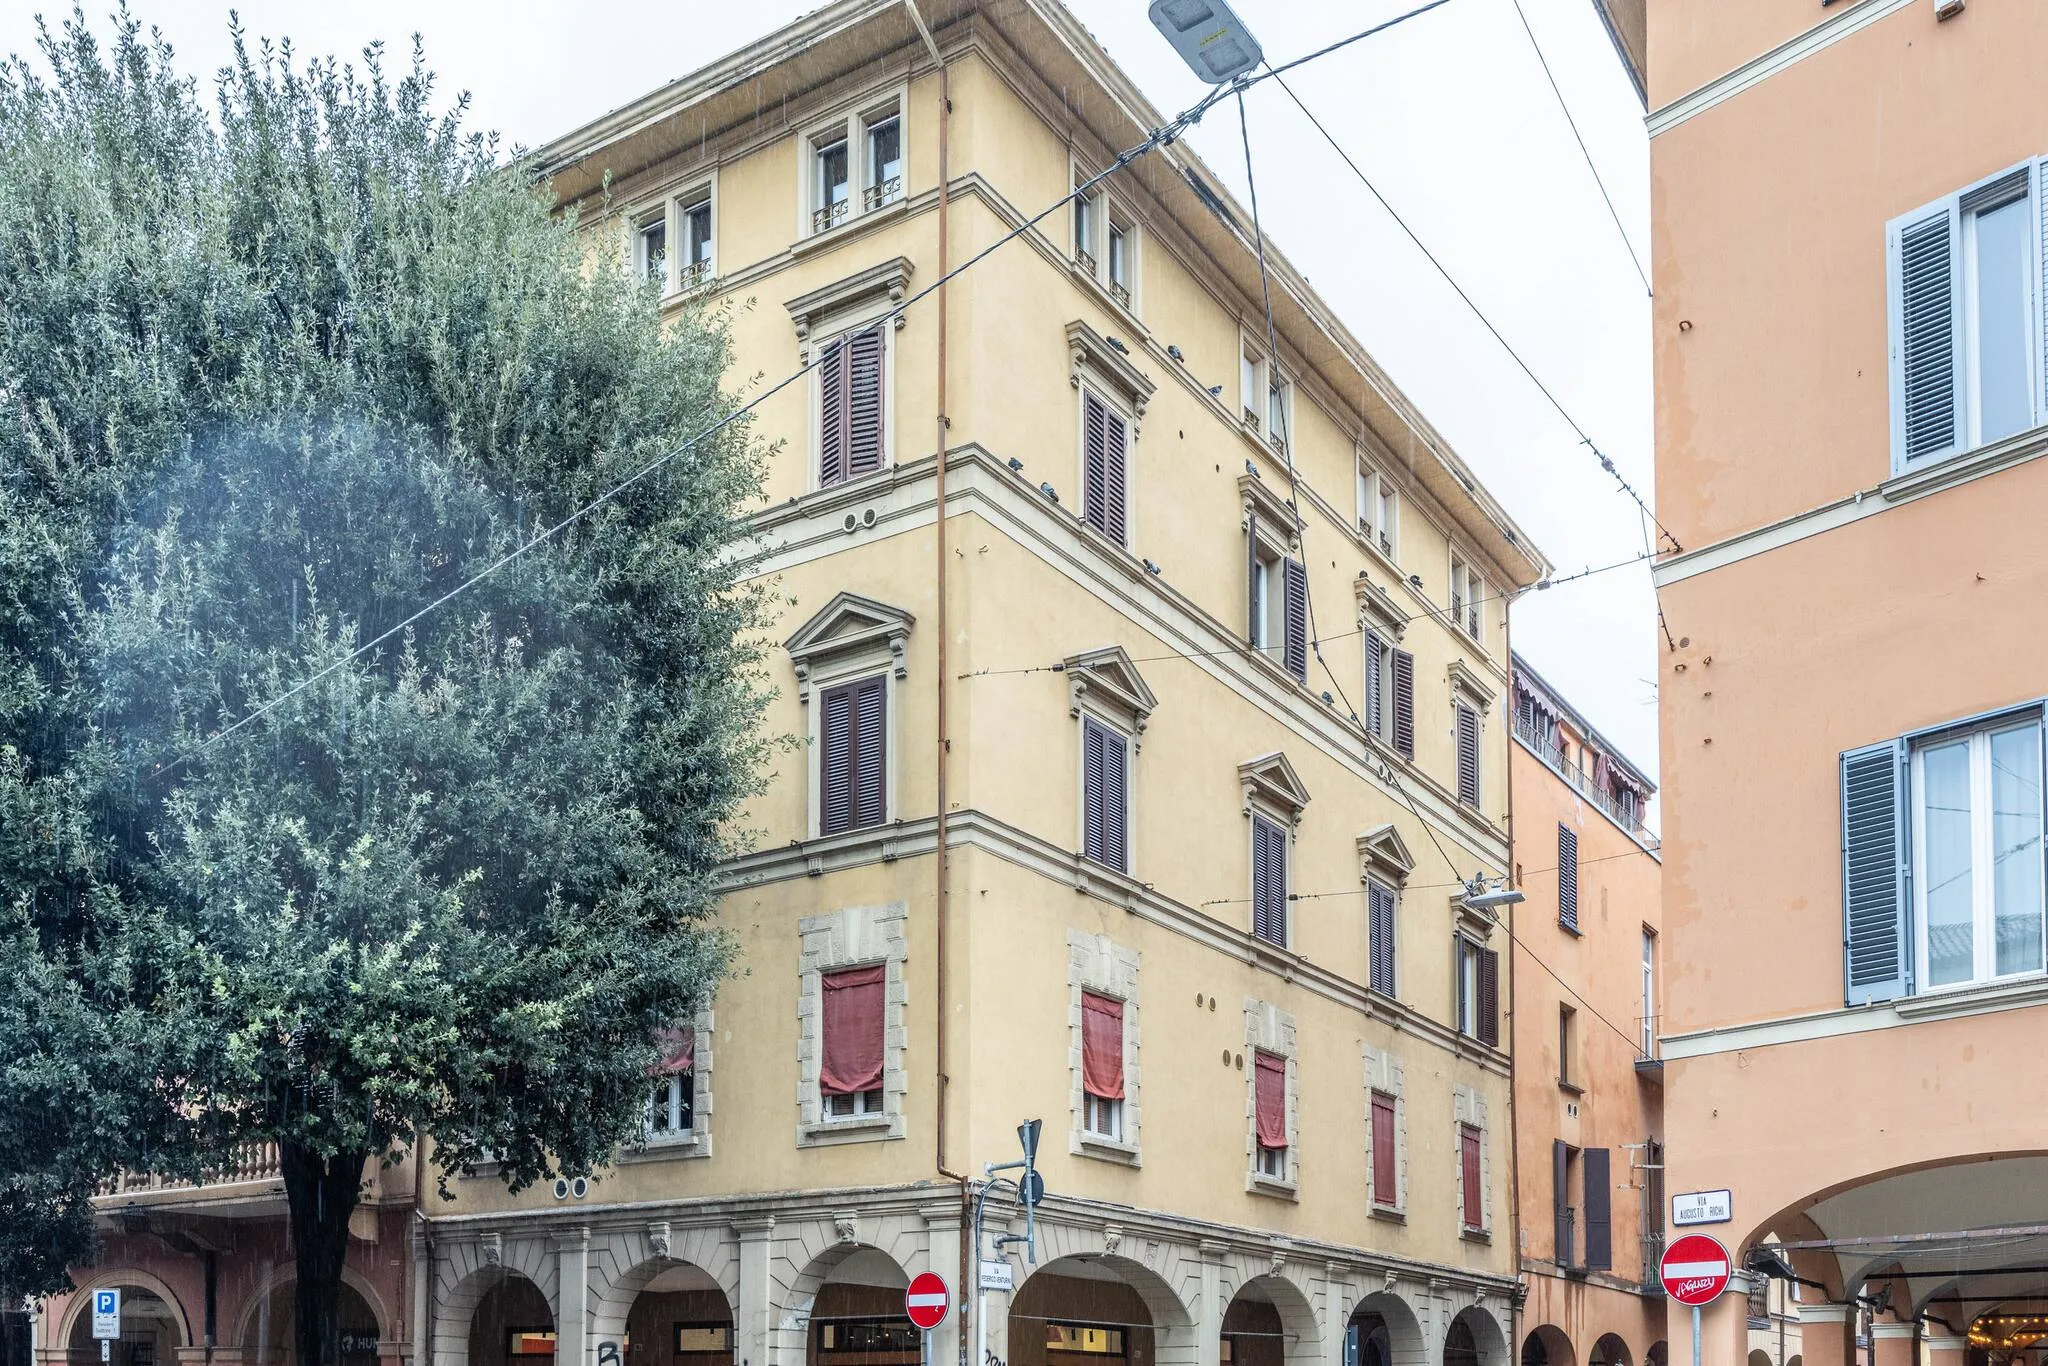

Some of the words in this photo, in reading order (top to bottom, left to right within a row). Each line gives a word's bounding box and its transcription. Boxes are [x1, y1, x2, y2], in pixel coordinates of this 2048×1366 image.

[1697, 1196, 1707, 1206] VIA
[1680, 1207, 1704, 1220] AUGUSTO
[101, 1295, 112, 1310] P
